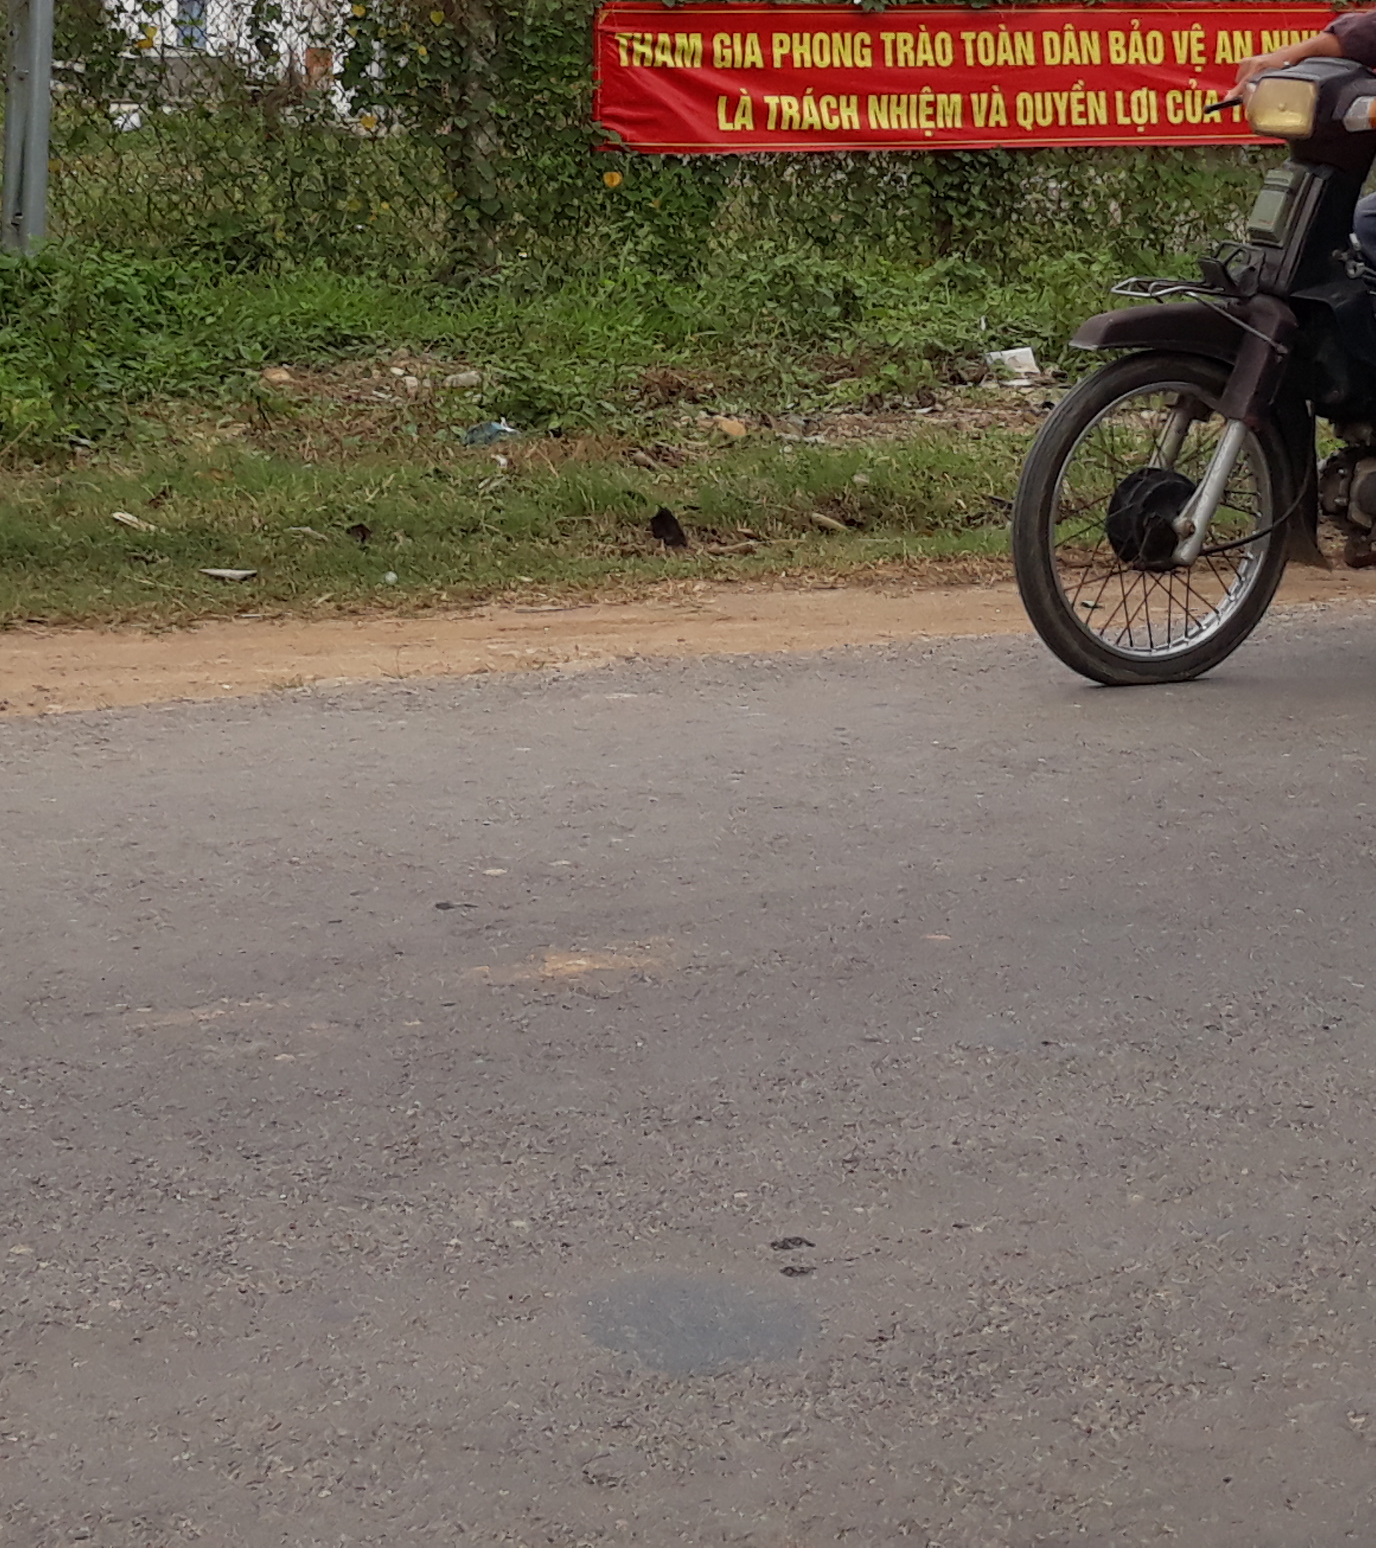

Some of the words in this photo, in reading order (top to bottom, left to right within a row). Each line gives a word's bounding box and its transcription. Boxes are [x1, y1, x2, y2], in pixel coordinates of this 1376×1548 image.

[615, 31, 703, 68] THAM
[712, 32, 764, 69] GIA
[772, 31, 873, 69] PHONG
[880, 24, 954, 68] TRÀO
[960, 21, 1035, 67] TOÀN
[1043, 23, 1102, 66] DÂN
[1108, 18, 1166, 66] BẢO
[1171, 22, 1209, 73] VỆ
[1215, 30, 1253, 64] AN
[716, 87, 755, 132] LÀ
[764, 87, 860, 131] TRÁCH
[868, 85, 963, 137] NHIỆM
[970, 84, 1007, 128] VÀ
[1015, 79, 1108, 130] QUYỀN
[1115, 86, 1158, 133] LỢI
[1165, 78, 1223, 125] CỦA
